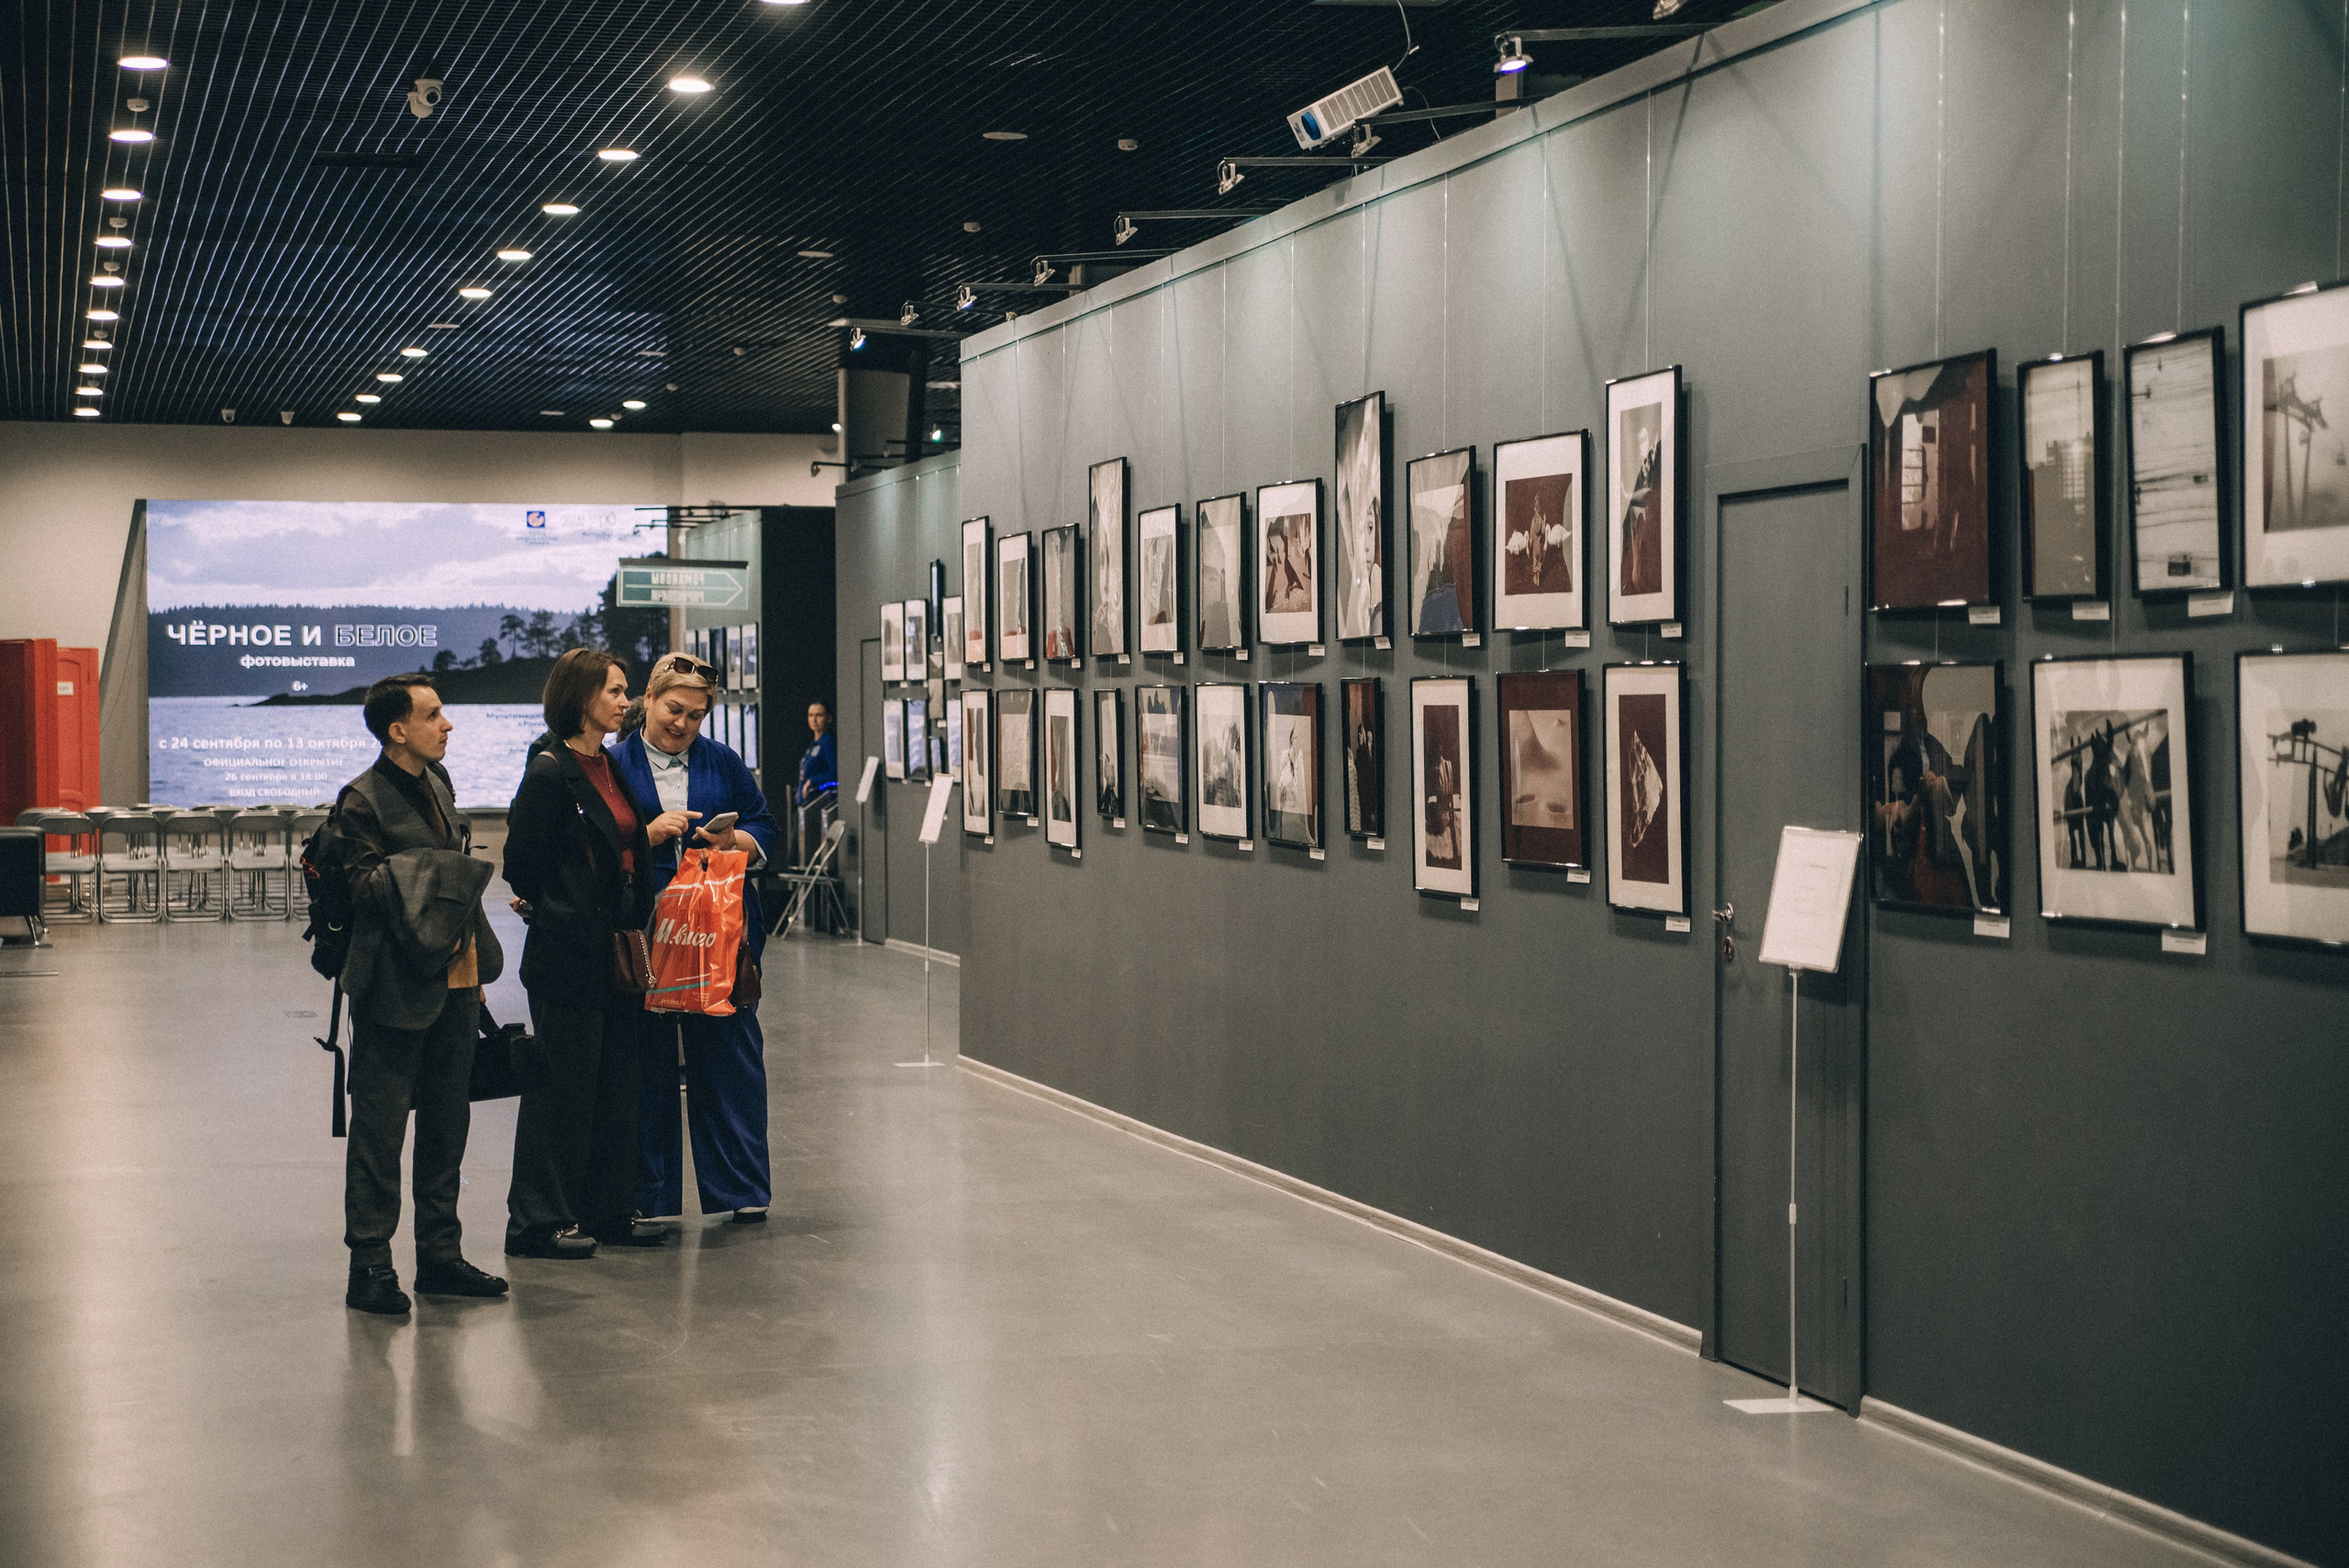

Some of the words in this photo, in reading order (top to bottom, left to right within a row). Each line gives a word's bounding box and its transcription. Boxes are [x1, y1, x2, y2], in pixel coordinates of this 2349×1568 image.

[167, 619, 292, 646] ЧЁРНОЕ
[302, 625, 322, 646] И
[335, 624, 438, 647] БЕЛОЕ
[240, 654, 355, 669] фотовыставка
[293, 680, 308, 692] 6+
[159, 739, 168, 750] с
[171, 736, 189, 750] 24
[193, 736, 261, 751] сентября
[264, 738, 283, 749] по
[308, 737, 365, 751] октября
[204, 757, 285, 768] ОФИЦИАЛЬНОЕ
[289, 757, 343, 767] ОТКРЫТИЕ
[225, 772, 238, 782] 26
[239, 772, 288, 783] сентября
[228, 787, 256, 797] ВХОД
[258, 786, 320, 797] СВОБОДНЫЙ
